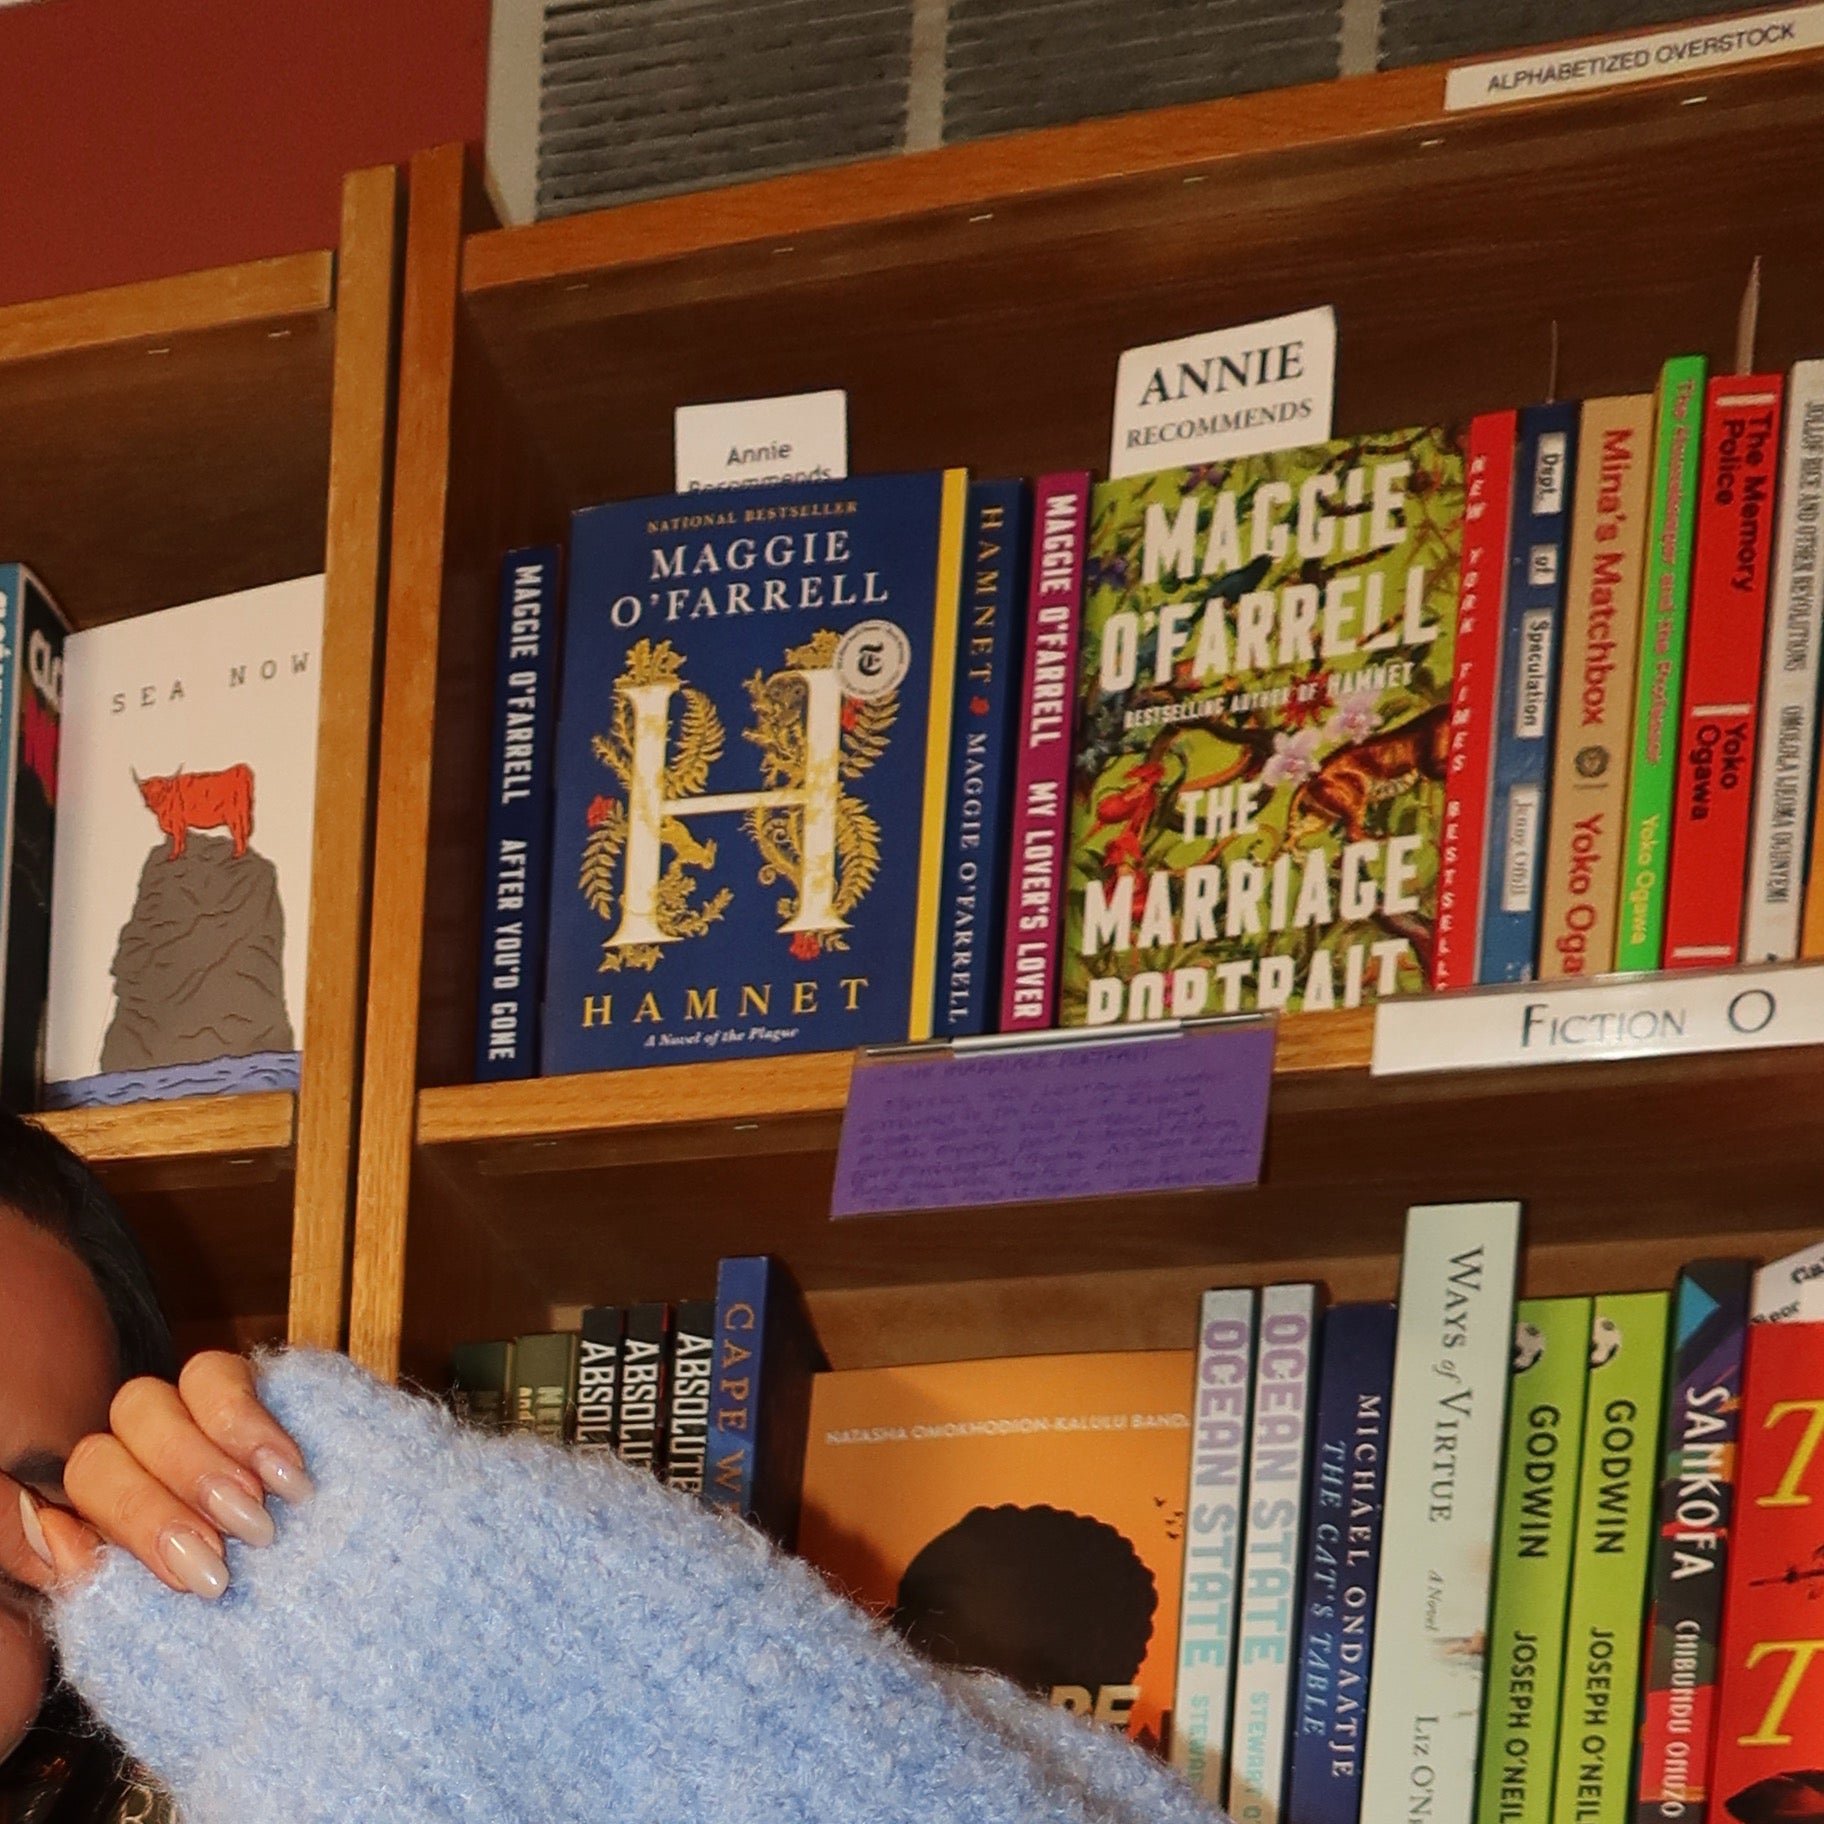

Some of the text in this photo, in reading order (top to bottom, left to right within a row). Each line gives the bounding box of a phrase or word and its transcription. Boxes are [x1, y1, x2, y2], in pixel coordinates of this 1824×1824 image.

[1487, 22, 1795, 93] ALPHABETIZED OVERSTOCK
[1139, 341, 1305, 406] ANNIE
[726, 440, 792, 467] Annie
[1126, 398, 1312, 450] RECOMMENDS
[1714, 419, 1746, 506] Police
[647, 501, 858, 533] NATIONAL BESTSELLER
[1142, 461, 1415, 586] MAGGIE
[1732, 412, 1773, 593] The Memory
[610, 571, 889, 629] O'FARRELL
[650, 530, 851, 580] MAGGIE
[1582, 428, 1634, 726] Mina's Matchbox
[1099, 565, 1441, 693] O'FARRELL
[111, 652, 311, 716] SEA NOW
[947, 504, 1005, 1024] HAMNET MAGGIE O'FARRELL
[1012, 492, 1079, 1022] MAGGIE O'FARRELL MY LOVER'S LOVER
[1688, 725, 1721, 821] Ogawa
[1719, 724, 1748, 789] Yoko
[487, 563, 544, 1062] MAGGIE O'FARRELL AFTER YOU'D GONE
[1177, 785, 1260, 842] THE
[1080, 836, 1424, 957] MARRIAGE
[1631, 816, 1659, 945] Yoko Ogawa
[579, 975, 871, 1028] HAMNET
[1086, 940, 1411, 1027] PORTRAIT
[1520, 989, 1776, 1049] FICTION O
[658, 1030, 702, 1047] Novel
[720, 1028, 745, 1044] the
[746, 1024, 799, 1047] Plague
[717, 1304, 756, 1433] CAPE
[1242, 1313, 1309, 1665] OCEAN STATE
[1518, 1403, 1560, 1560] GODWIN
[1303, 1439, 1346, 1737] THE CAT'S TABLE
[1331, 1393, 1381, 1779] MICHAEL ONDAATJE
[1502, 1630, 1538, 1730] JOSEPH
